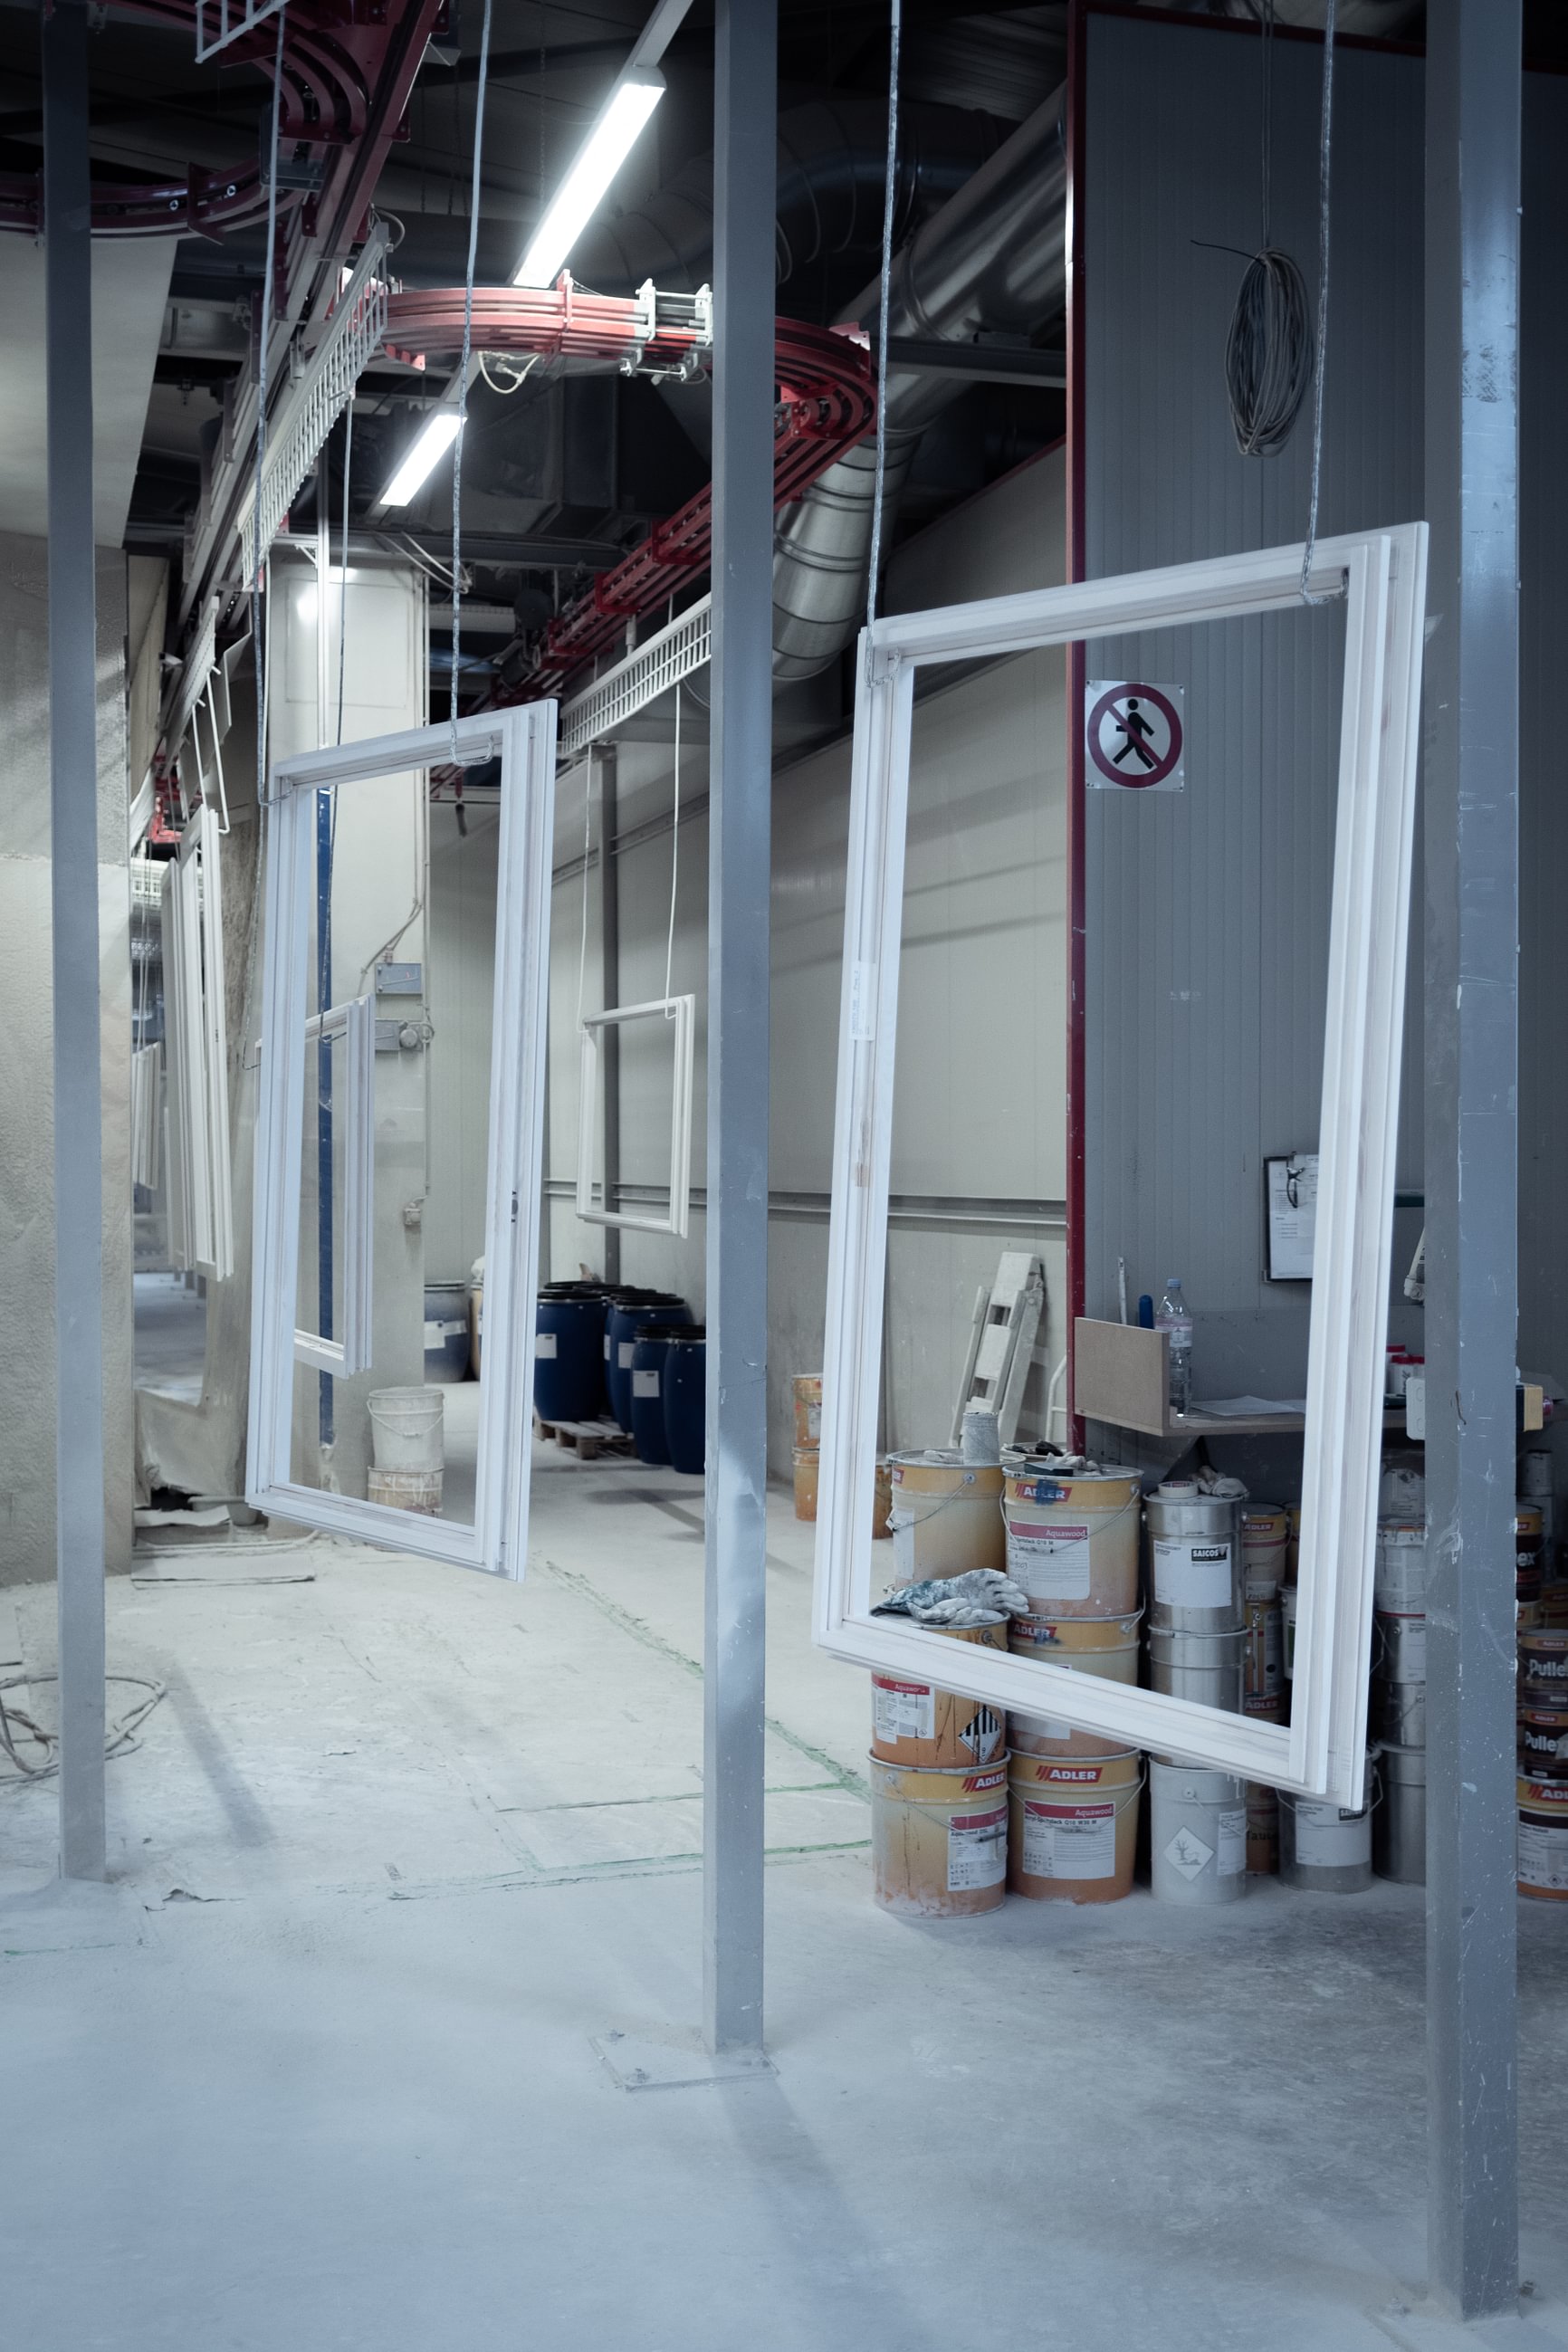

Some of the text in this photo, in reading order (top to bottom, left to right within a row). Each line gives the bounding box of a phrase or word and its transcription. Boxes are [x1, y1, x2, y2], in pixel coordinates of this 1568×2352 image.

[1046, 1529, 1086, 1538] Aquawood
[1192, 1549, 1219, 1558] SAICOS
[1013, 1624, 1050, 1638] ADLER
[1528, 1659, 1568, 1678] Pulle
[894, 1684, 926, 1694] Aquawo
[1525, 1731, 1558, 1752] Pulle
[1050, 1769, 1096, 1780] ADLER
[1541, 1789, 1568, 1801] ADL
[1075, 1807, 1113, 1817] Aquawood
